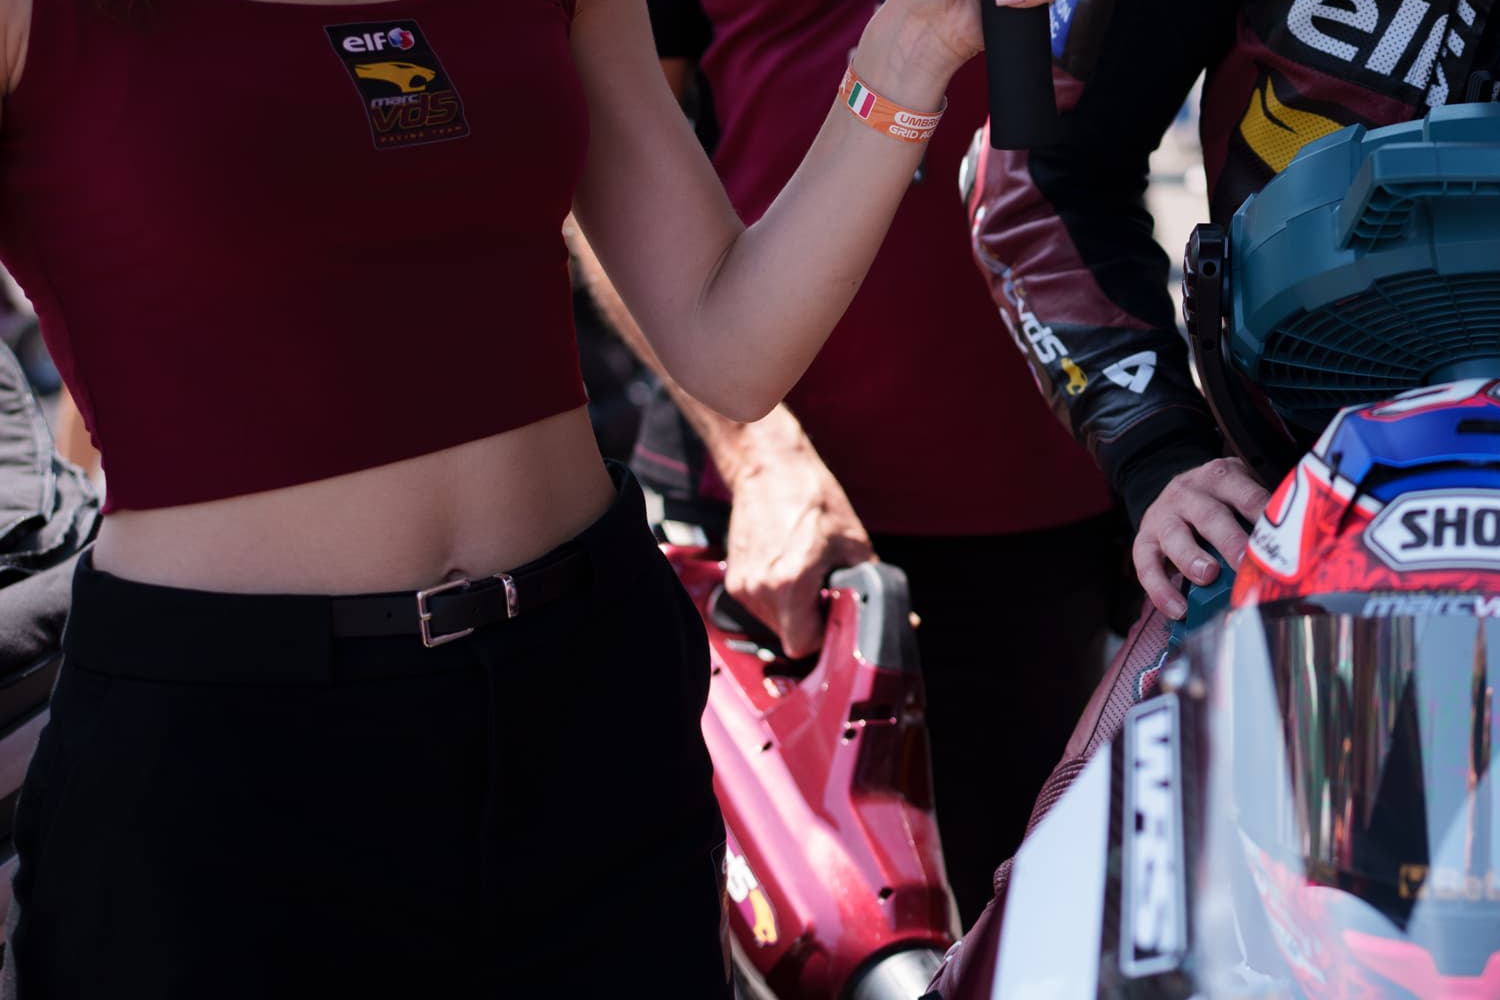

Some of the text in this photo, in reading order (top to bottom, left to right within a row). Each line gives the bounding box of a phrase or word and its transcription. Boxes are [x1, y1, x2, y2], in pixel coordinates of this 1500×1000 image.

[342, 32, 387, 52] elf
[371, 93, 419, 107] marc
[889, 125, 919, 139] GRID
